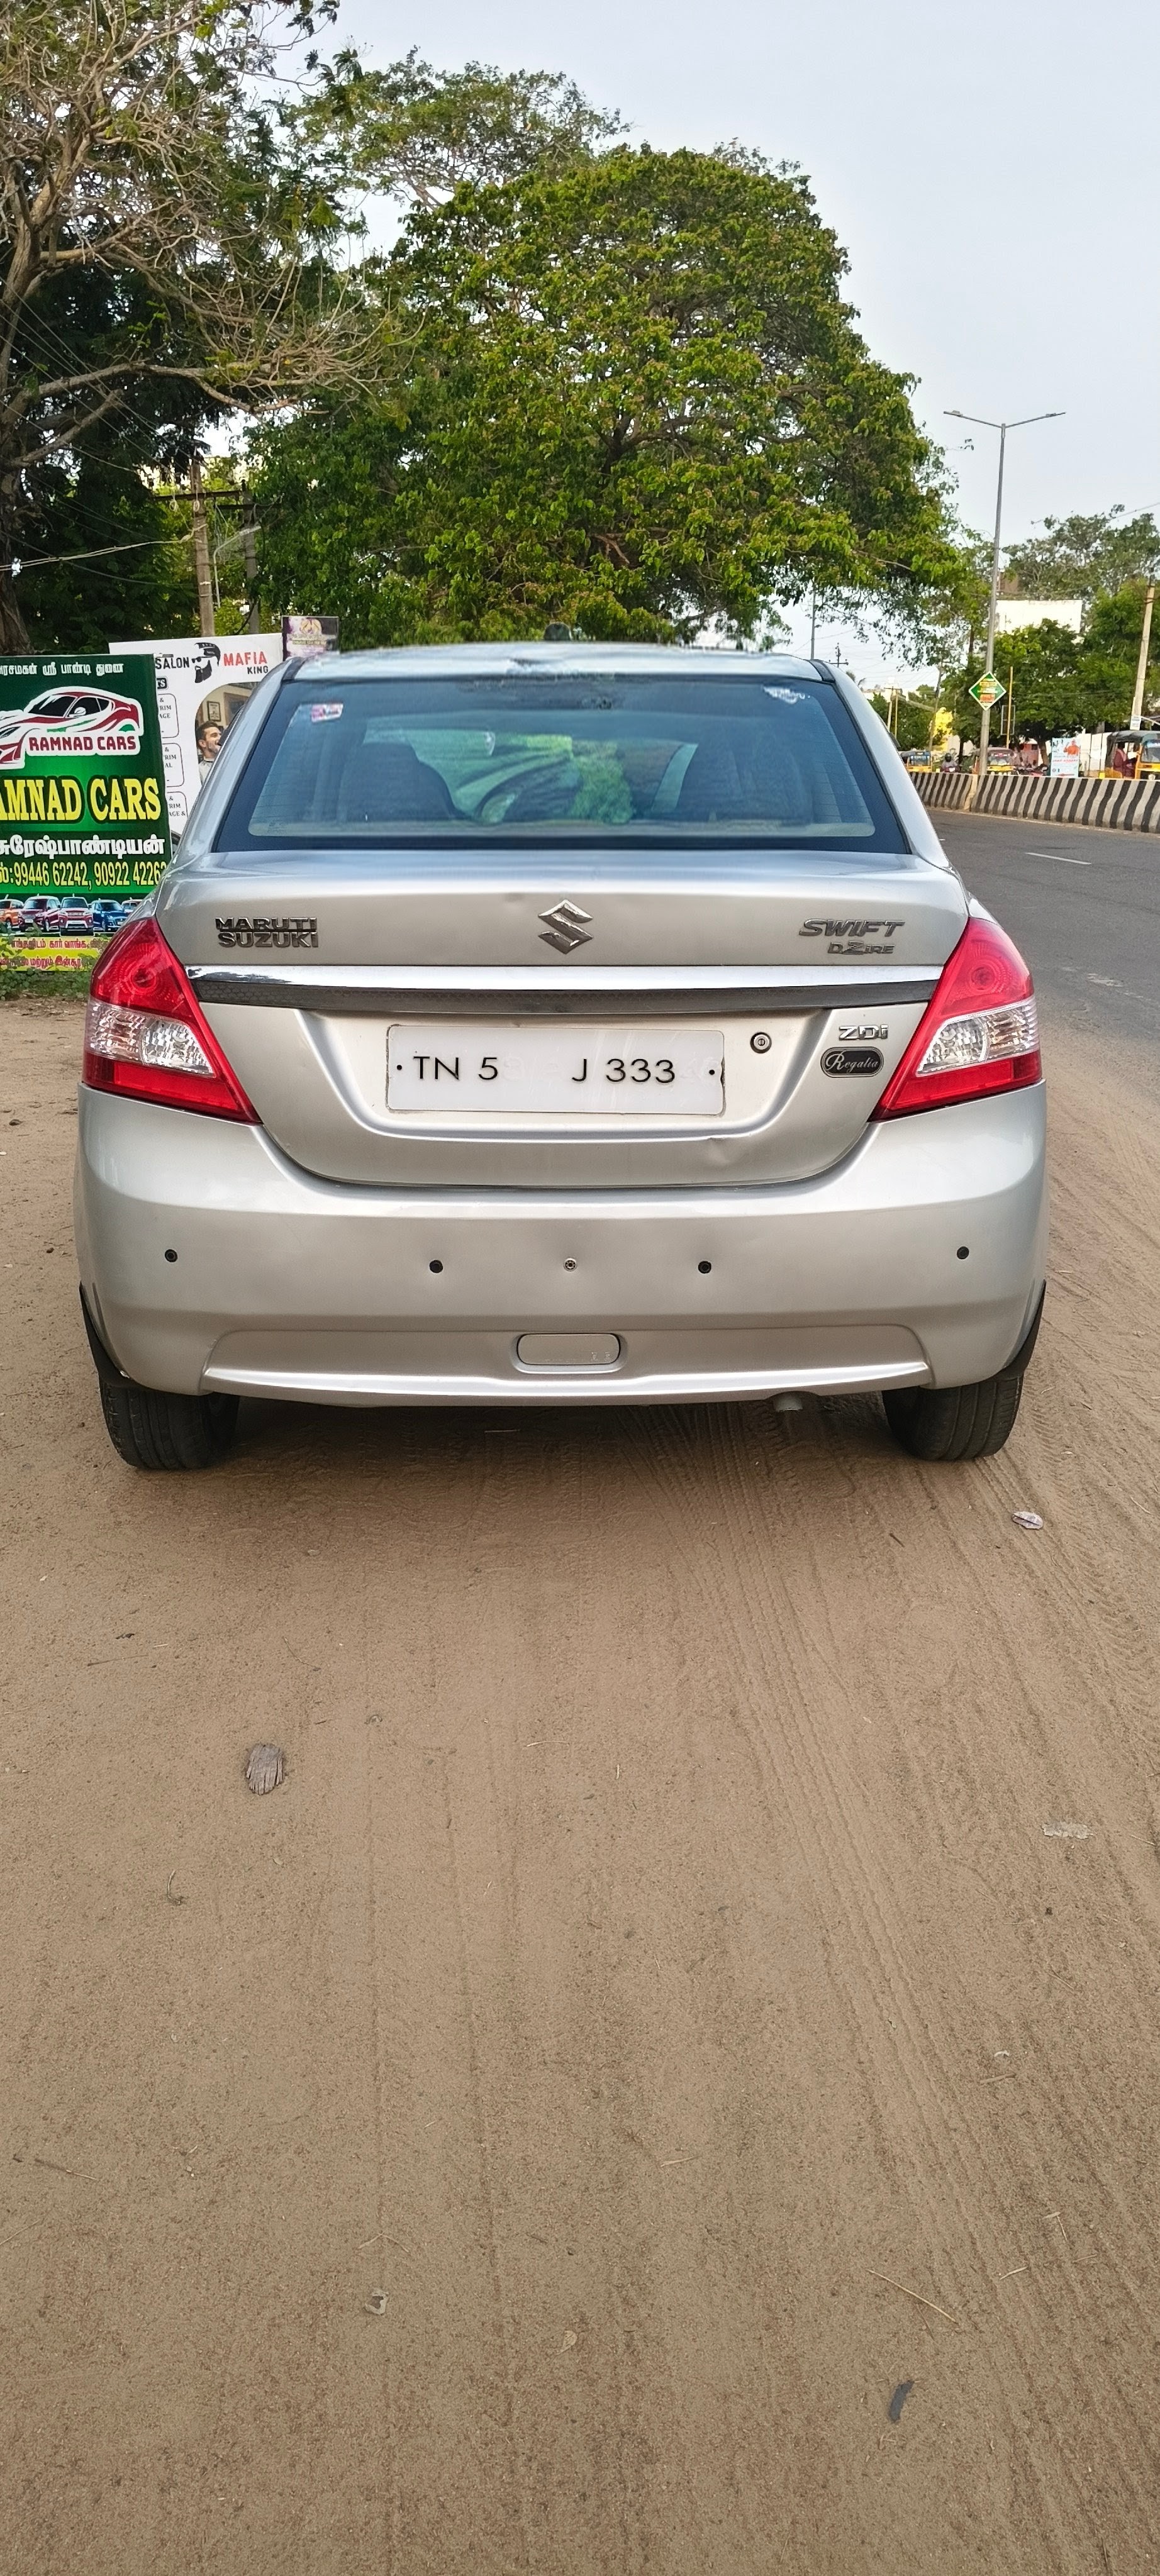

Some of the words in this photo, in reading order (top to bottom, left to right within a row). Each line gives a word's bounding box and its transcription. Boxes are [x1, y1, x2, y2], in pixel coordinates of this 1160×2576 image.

[155, 657, 189, 669] SALON
[223, 651, 267, 667] MAFIA
[60, 662, 92, 676] பாண்டி
[247, 666, 269, 675] KING
[29, 736, 93, 751] RAMNAD
[97, 736, 137, 751] CARS
[90, 777, 161, 821] CARS
[53, 862, 92, 890] 62242,
[94, 862, 130, 886] 90922
[215, 917, 317, 931] MARUTI
[799, 919, 905, 937] SWIFT
[218, 931, 319, 948] SUZUKI
[825, 1050, 879, 1074] Regalia
[413, 1056, 461, 1081] TN
[571, 1058, 588, 1084] J
[605, 1058, 676, 1085] 333
